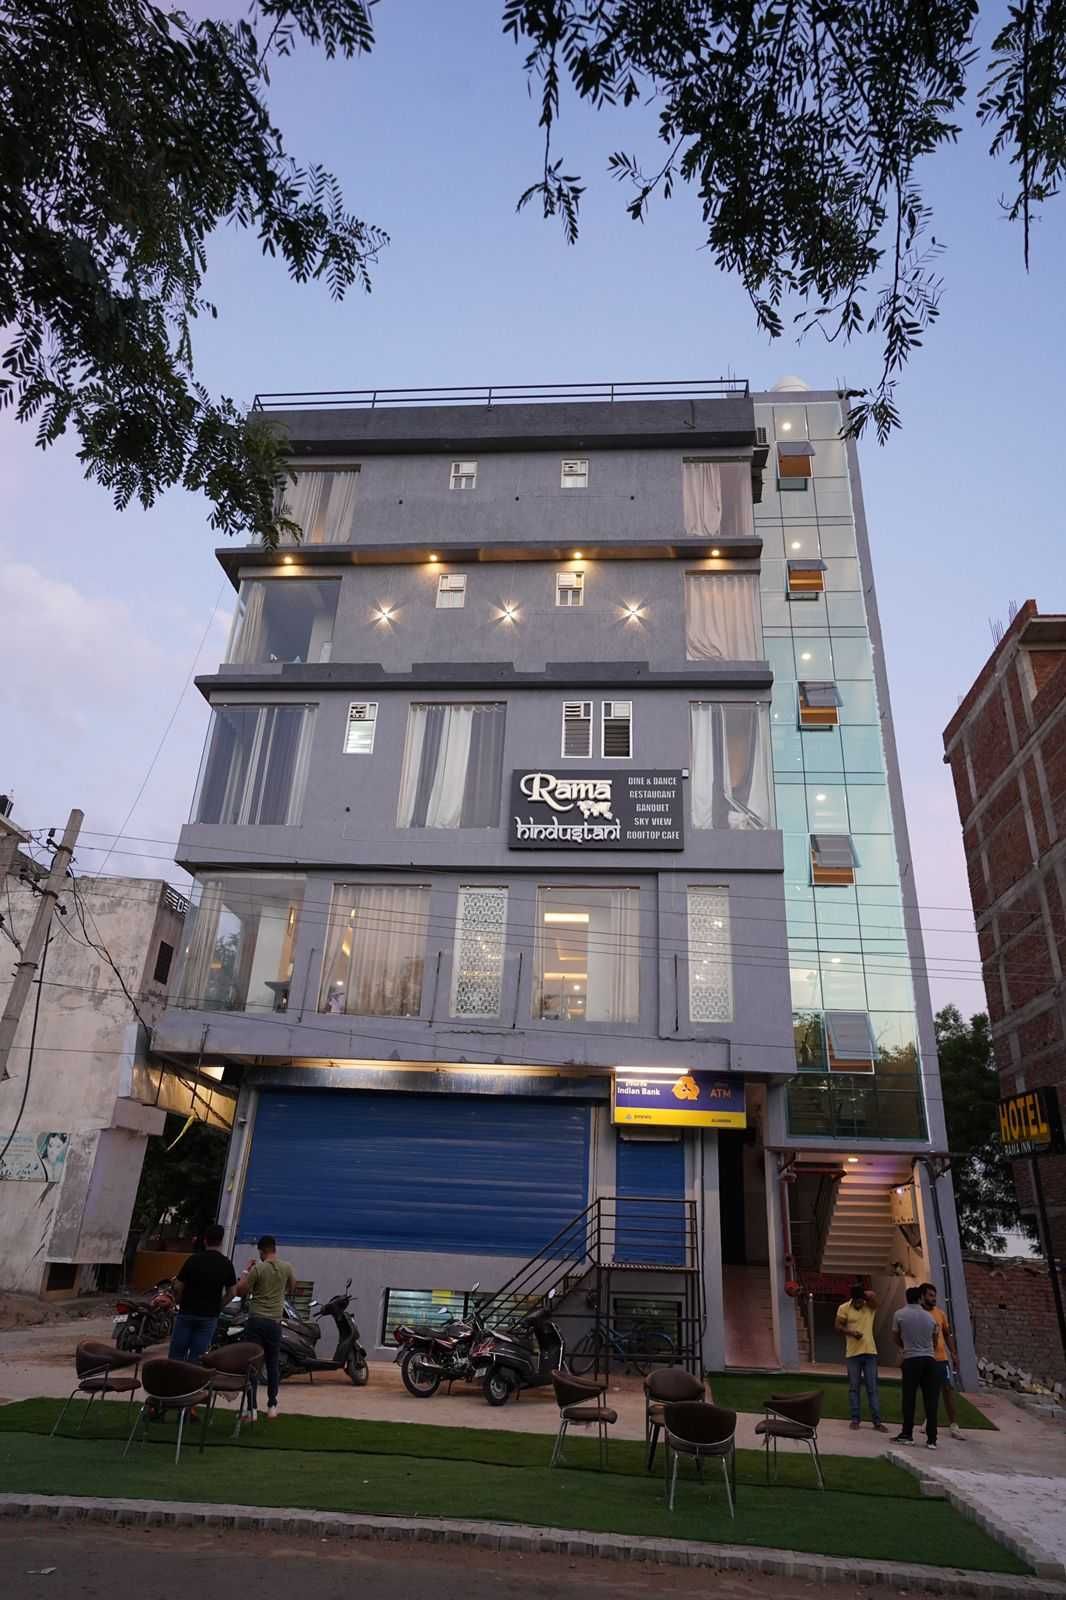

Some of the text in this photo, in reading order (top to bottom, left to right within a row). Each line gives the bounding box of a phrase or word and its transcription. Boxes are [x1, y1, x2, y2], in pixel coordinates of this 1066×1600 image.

[628, 776, 645, 785] DINE
[653, 776, 677, 785] DANCE
[520, 772, 612, 811] Rama
[629, 790, 676, 799] RESTAURANT
[636, 803, 669, 812] BANQUET
[633, 817, 672, 826] SKY VIEW
[626, 831, 680, 840] ROOFTOP CAFE
[617, 1087, 661, 1096] Indian Bank
[710, 1089, 731, 1099] ATM
[998, 1092, 1048, 1141] HOTEL
